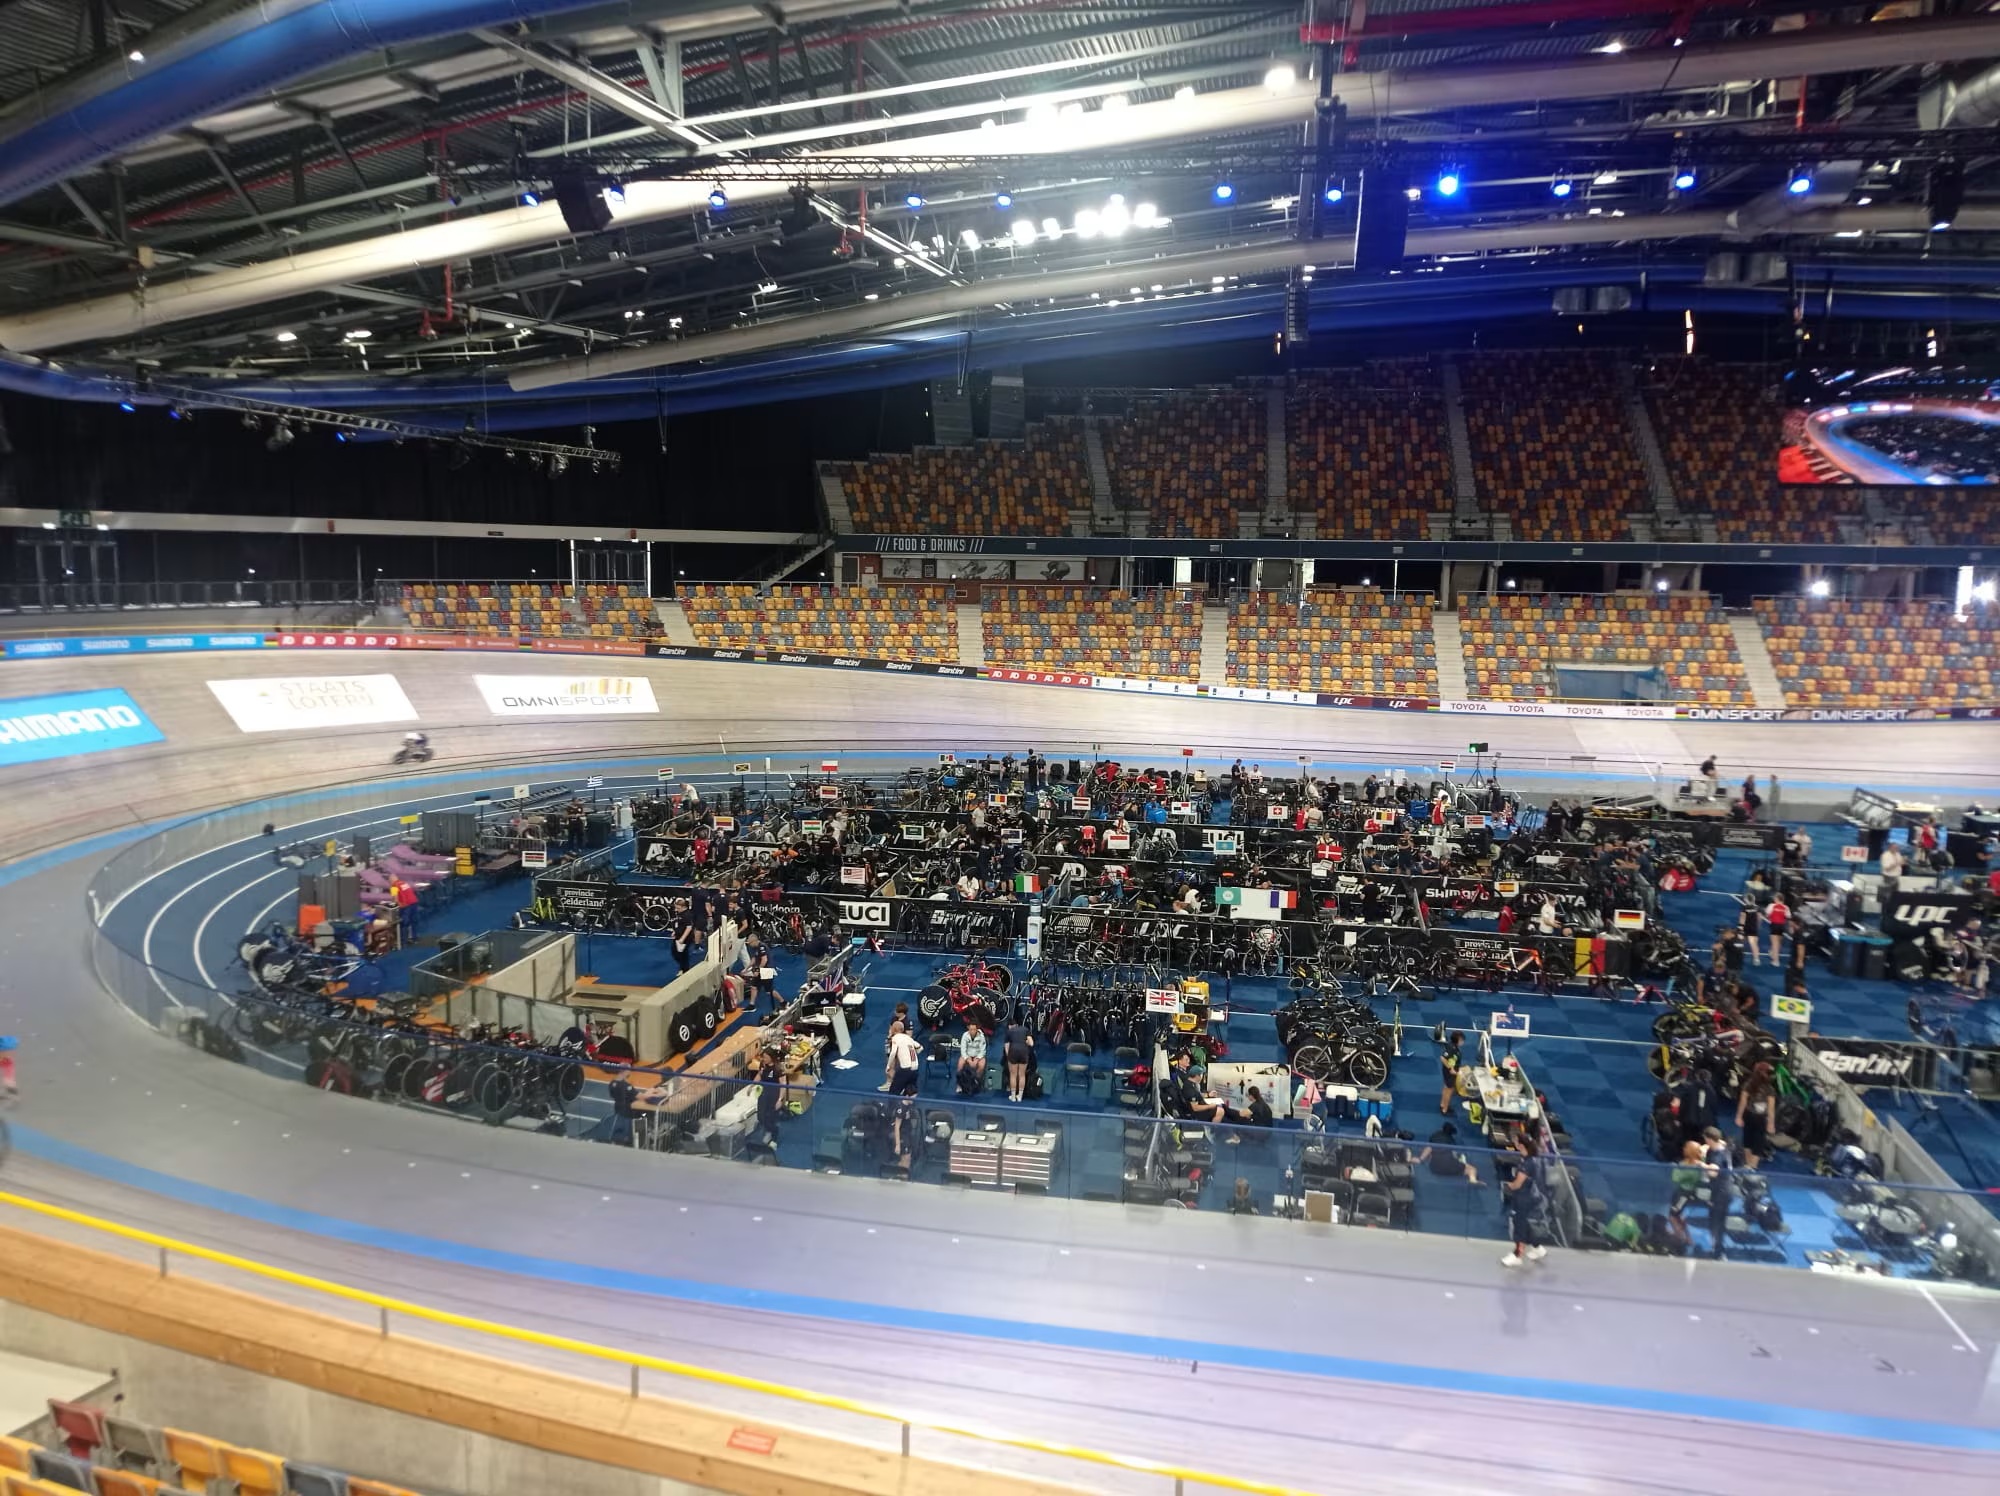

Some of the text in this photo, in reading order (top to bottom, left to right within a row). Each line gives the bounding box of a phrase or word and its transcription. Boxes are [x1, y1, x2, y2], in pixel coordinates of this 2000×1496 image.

[893, 538, 917, 551] FOOD
[920, 539, 926, 551] &
[931, 539, 966, 552] DRINKS
[658, 647, 687, 656] Santini
[713, 650, 742, 659] Santini
[779, 654, 807, 663] Santini
[833, 658, 861, 667] Santini
[886, 662, 913, 671] Santini
[938, 666, 965, 675] Santini
[280, 681, 367, 695] STAATS
[502, 696, 633, 707] OMNISPORT
[1451, 702, 1487, 711] TOYOTA
[1508, 705, 1545, 713] TOYOTA
[1567, 707, 1603, 715] TOYOTA
[1626, 708, 1664, 717] TOYOTA
[1689, 708, 1785, 720] OMNISPORT
[1811, 709, 1907, 720] OMNISPORT
[0, 705, 141, 744] HIMANO
[564, 888, 595, 898] provincie
[560, 897, 605, 908] Gelderland
[847, 905, 887, 922] UCI
[1818, 1050, 1913, 1076] Santini
